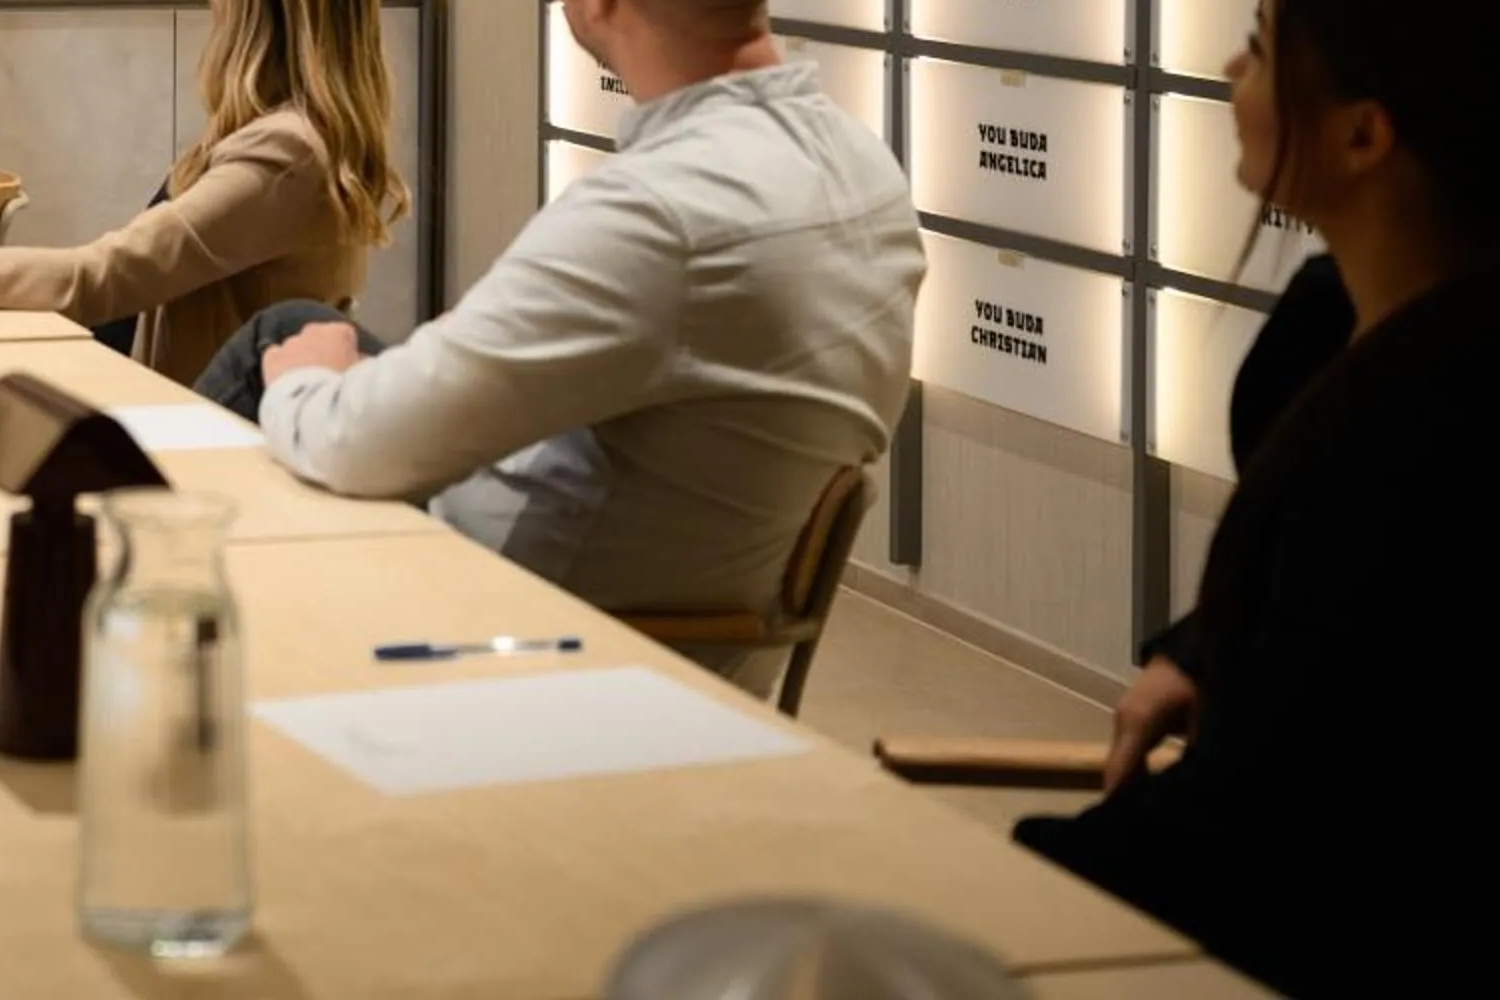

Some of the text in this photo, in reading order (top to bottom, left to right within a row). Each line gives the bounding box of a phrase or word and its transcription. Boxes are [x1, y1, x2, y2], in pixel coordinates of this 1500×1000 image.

[978, 123, 1047, 153] YOU BUDA
[979, 150, 1047, 180] ANGELICA
[975, 299, 1044, 336] YOU BUDA
[971, 325, 1047, 364] CHRISTIAN
